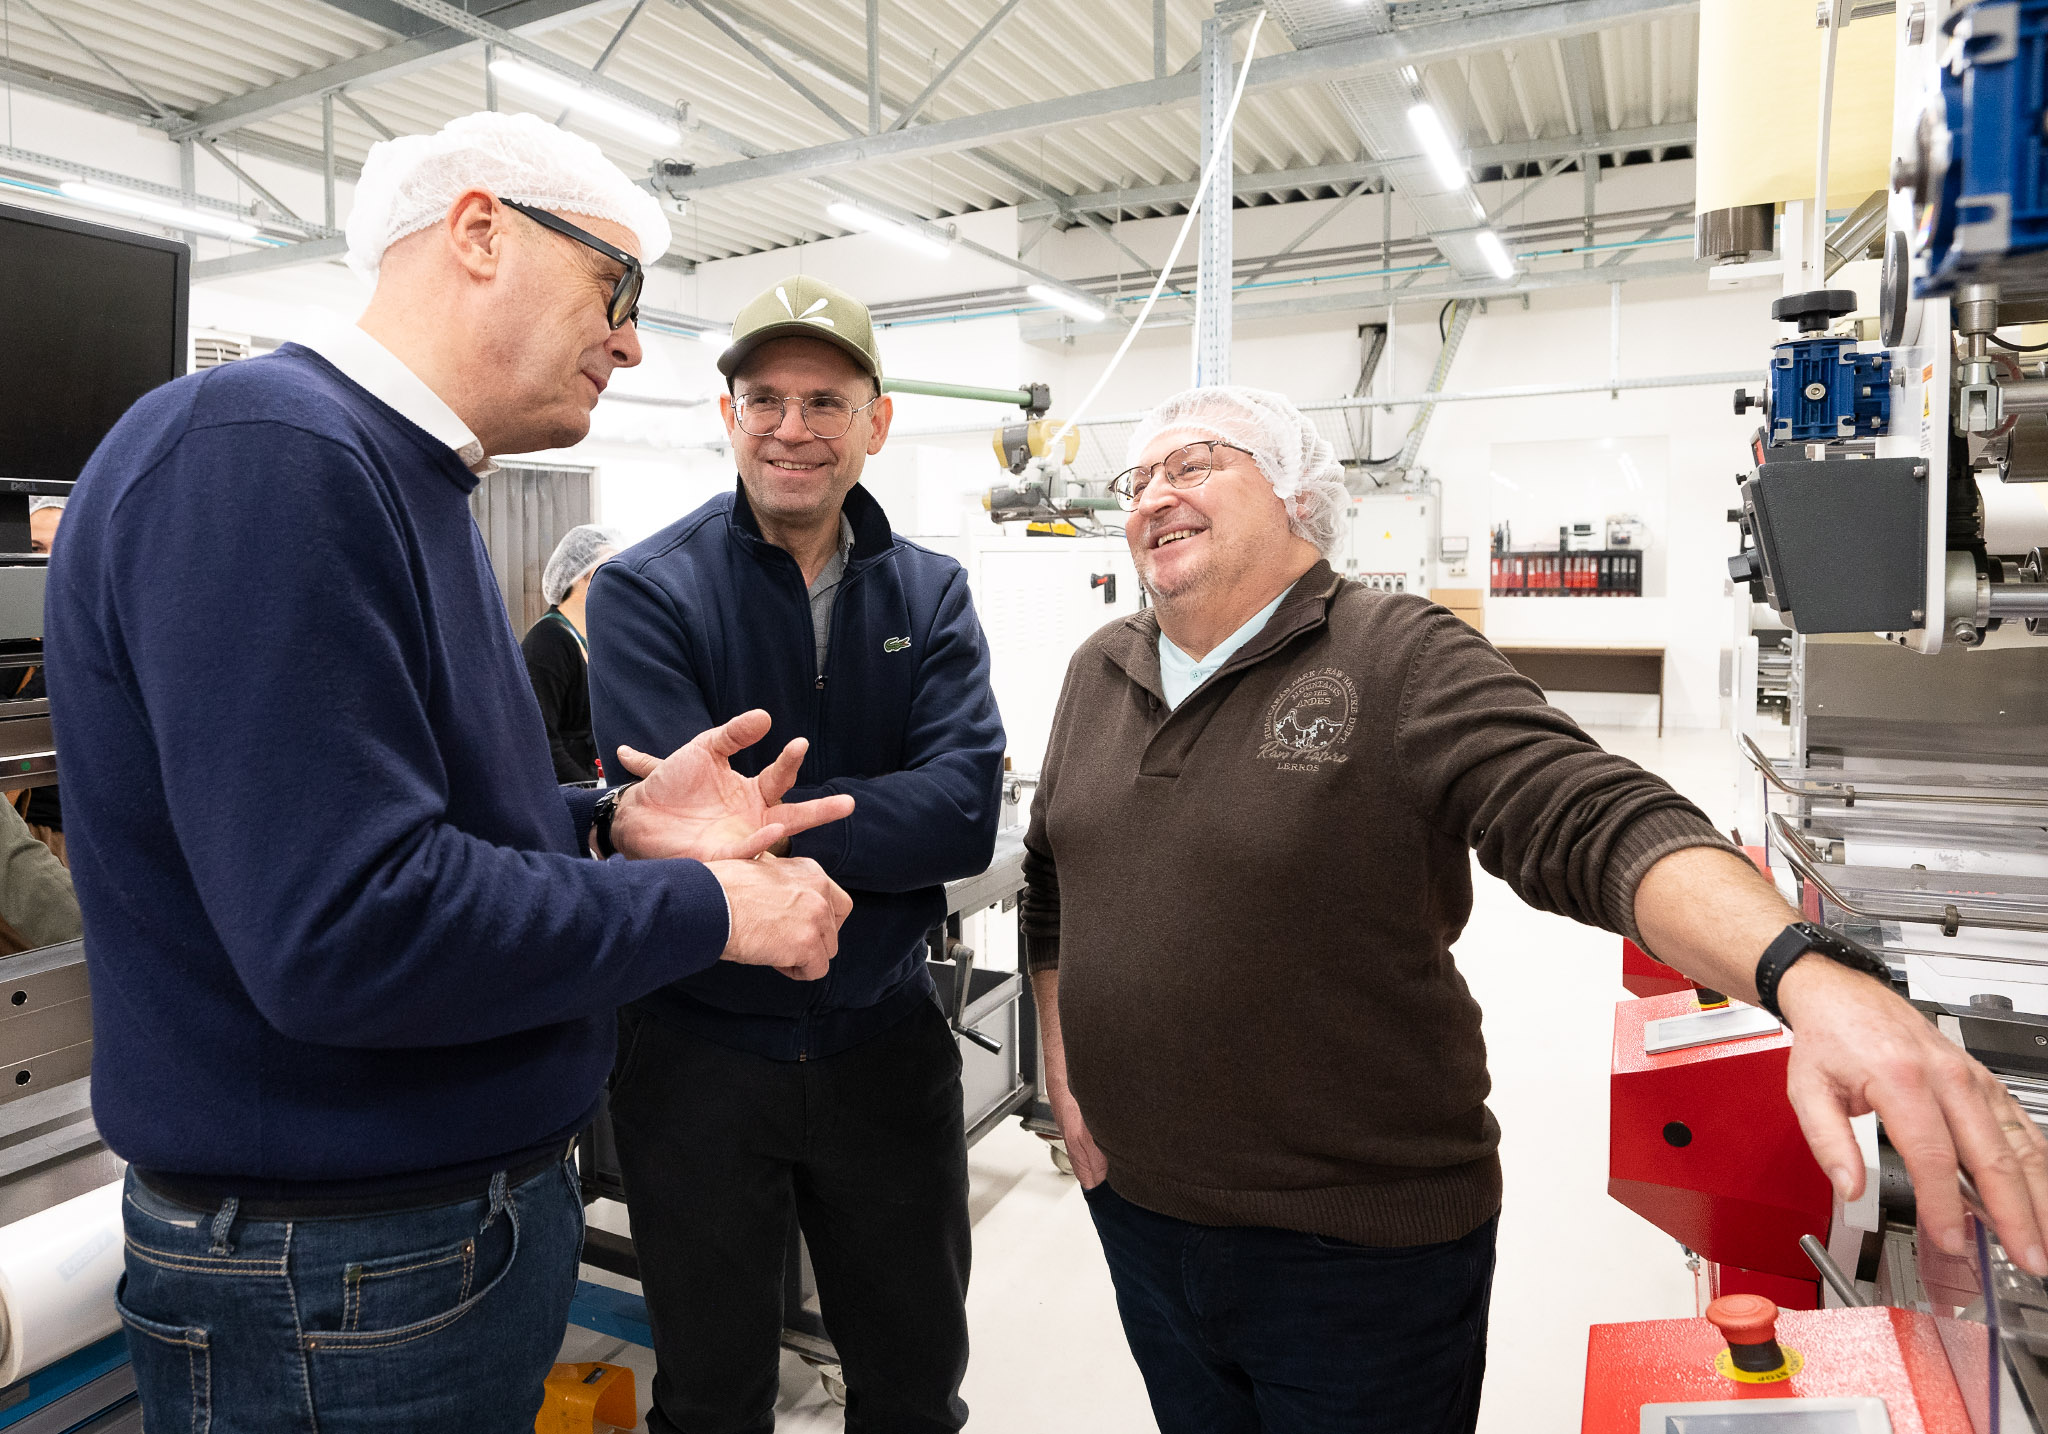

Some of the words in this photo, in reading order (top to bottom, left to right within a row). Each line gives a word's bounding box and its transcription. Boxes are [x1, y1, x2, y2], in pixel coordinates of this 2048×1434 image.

[10, 481, 37, 492] DELL
[1290, 680, 1342, 700] MOUNTAINS
[1292, 669, 1316, 687] PARK
[1324, 667, 1344, 678] RAW
[1342, 675, 1359, 714] NATURE
[1313, 689, 1328, 697] THE
[1295, 697, 1332, 708] ANDES
[1256, 740, 1290, 760] Raw
[1290, 737, 1349, 763] Nature
[1276, 761, 1320, 772] LERROS
